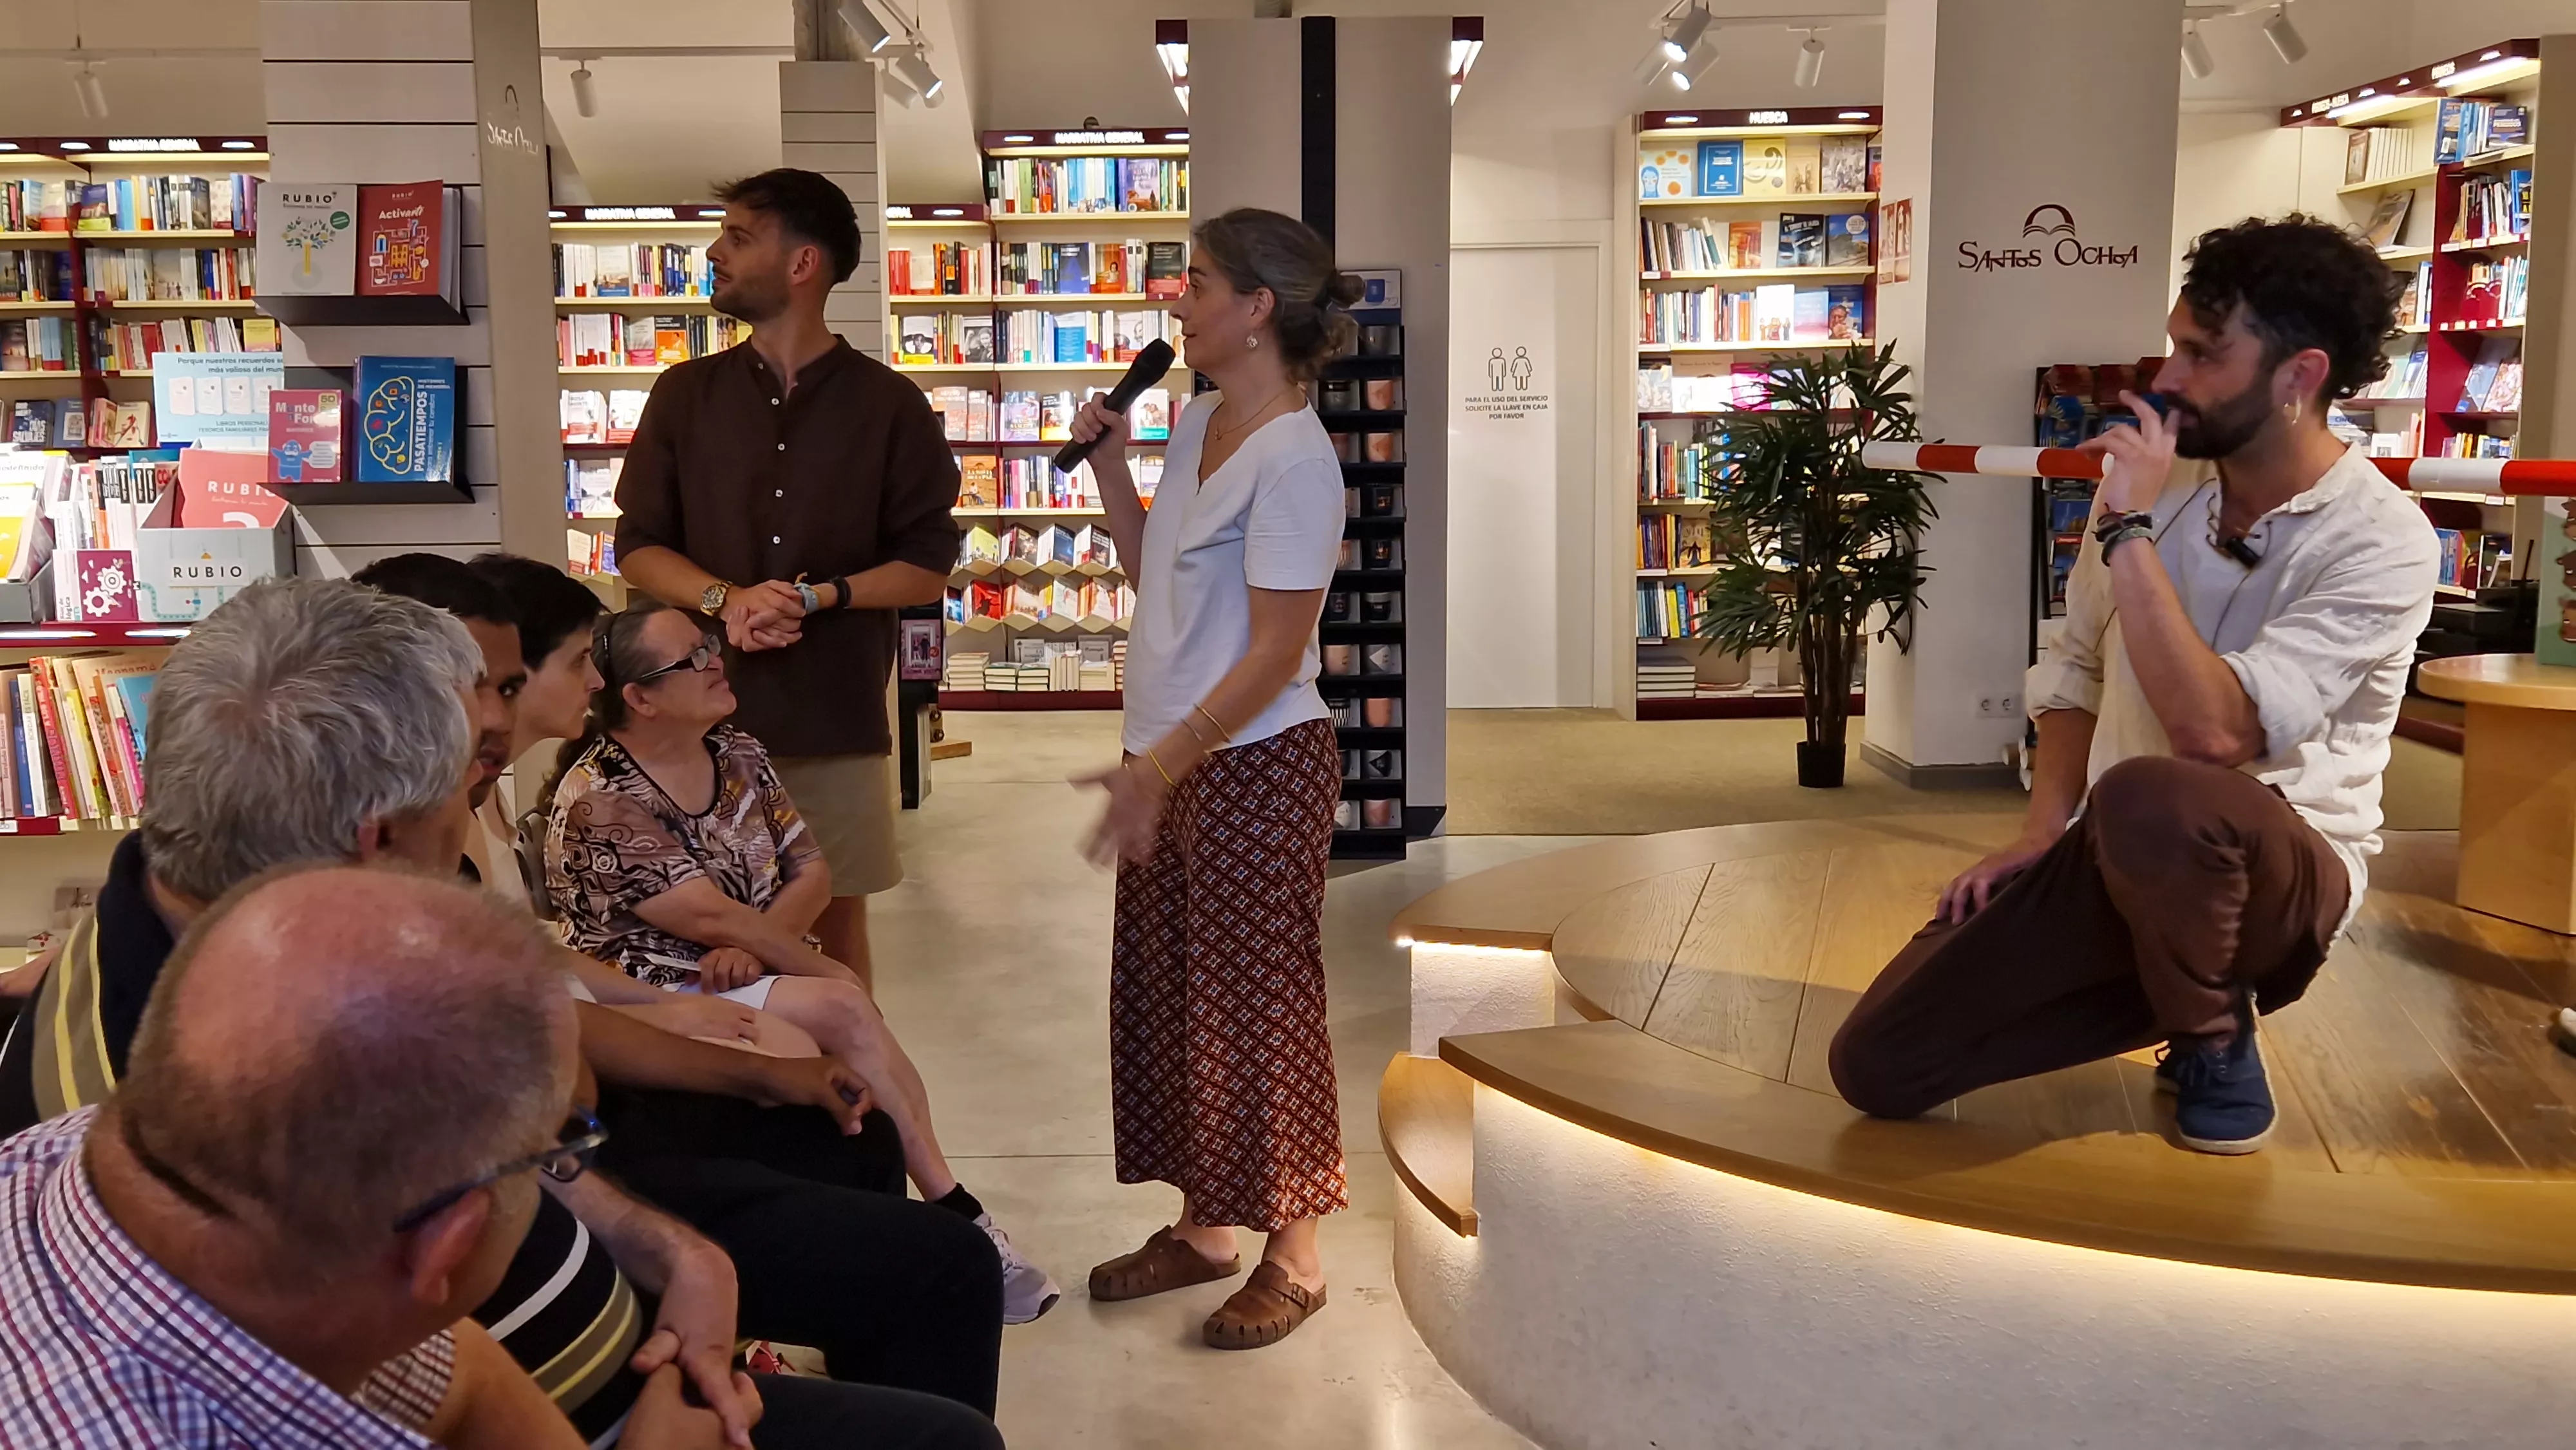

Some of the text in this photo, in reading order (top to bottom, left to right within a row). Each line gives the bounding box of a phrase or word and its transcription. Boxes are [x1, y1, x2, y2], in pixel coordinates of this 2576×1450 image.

[283, 194, 332, 203] RUBIO
[414, 391, 428, 471] PASATIEMPOS
[173, 566, 242, 578] RUBIO
